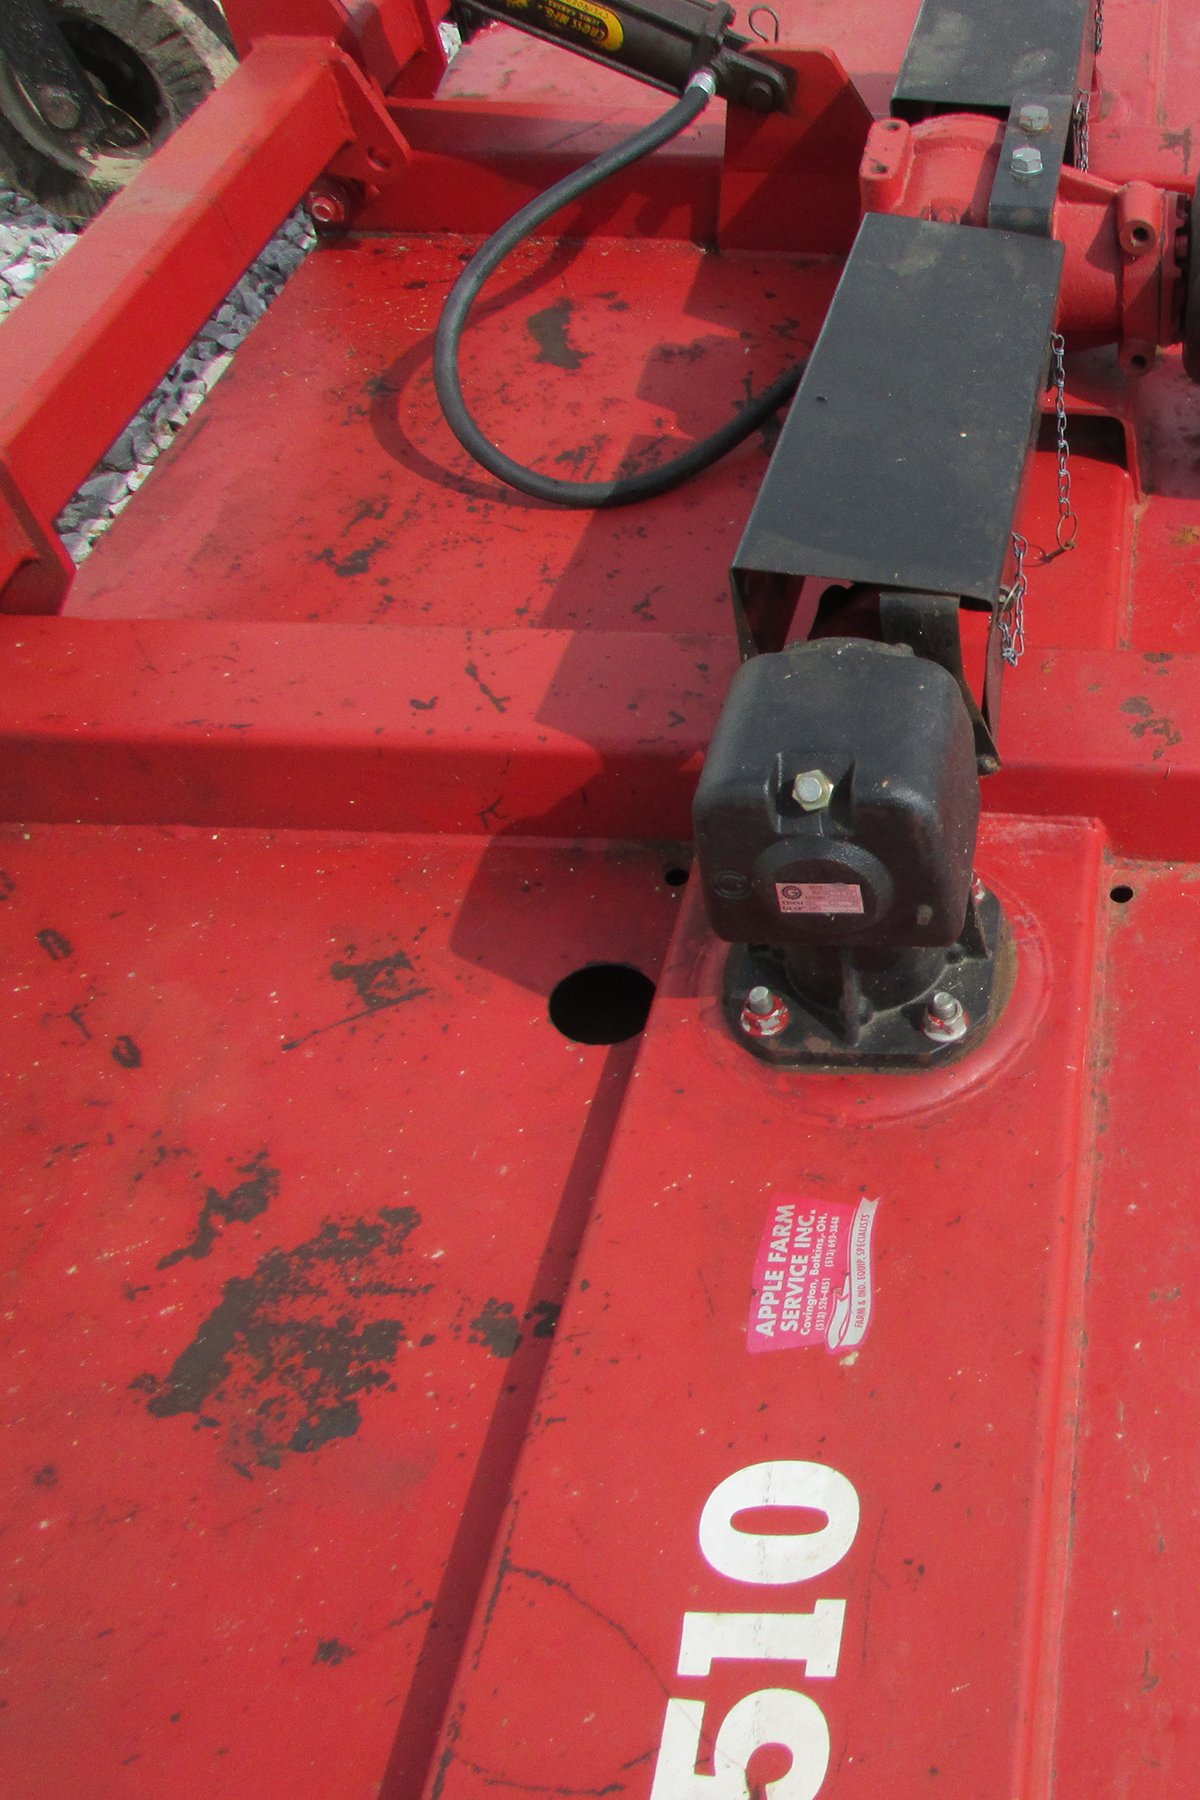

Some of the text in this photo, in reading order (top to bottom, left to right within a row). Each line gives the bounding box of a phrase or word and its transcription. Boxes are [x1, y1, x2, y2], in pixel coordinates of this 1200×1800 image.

[857, 1214, 869, 1256] SPECIALISTS
[755, 1204, 795, 1337] APPLE FARM
[780, 1209, 816, 1332] SERVICE INC.
[801, 1279, 818, 1335] Covington,
[810, 1234, 825, 1275] Botkins,
[816, 1312, 827, 1330] (513)
[825, 1250, 835, 1267] (513)
[856, 1257, 866, 1280] EQUIP.
[857, 1282, 866, 1297] IND.
[854, 1308, 864, 1328] FARM
